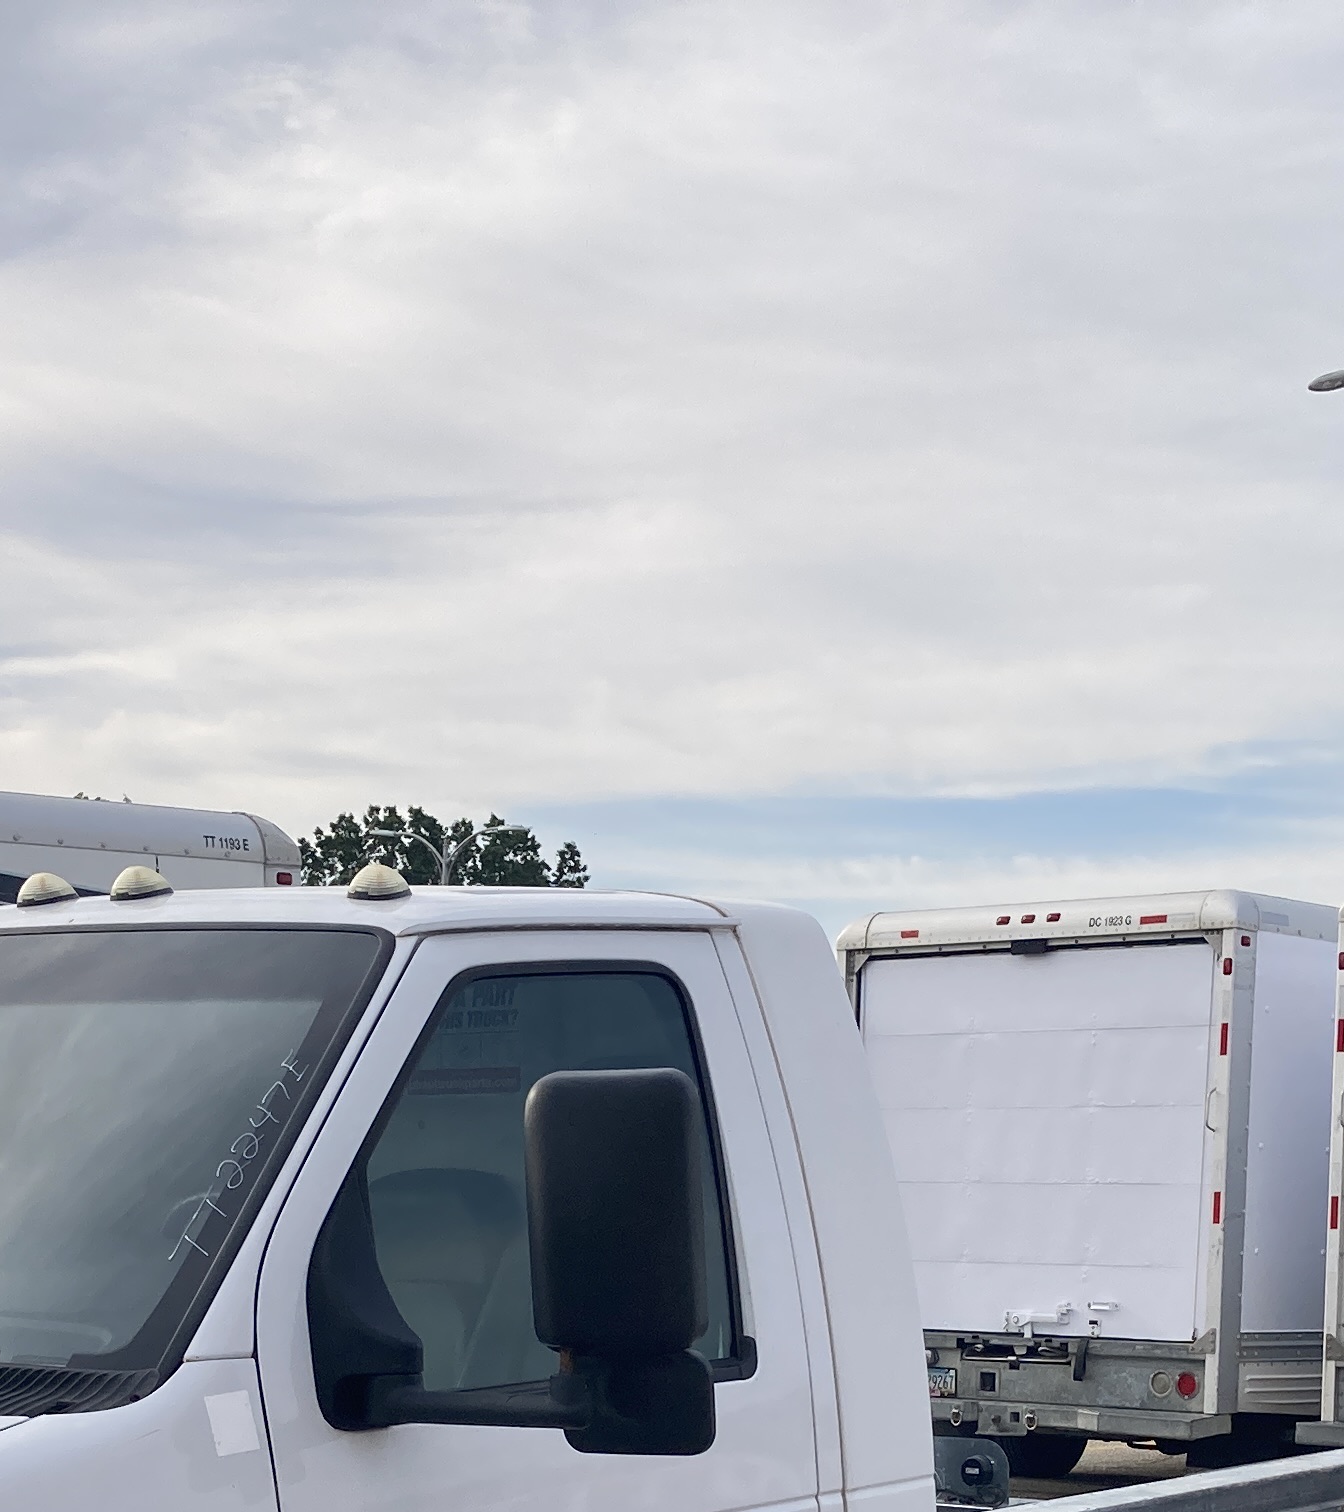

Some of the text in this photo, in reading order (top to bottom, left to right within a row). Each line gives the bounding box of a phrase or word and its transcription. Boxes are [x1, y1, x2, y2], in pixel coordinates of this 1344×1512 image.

[202, 834, 250, 852] TT 1193 E
[1088, 914, 1132, 928] DC 1923 G
